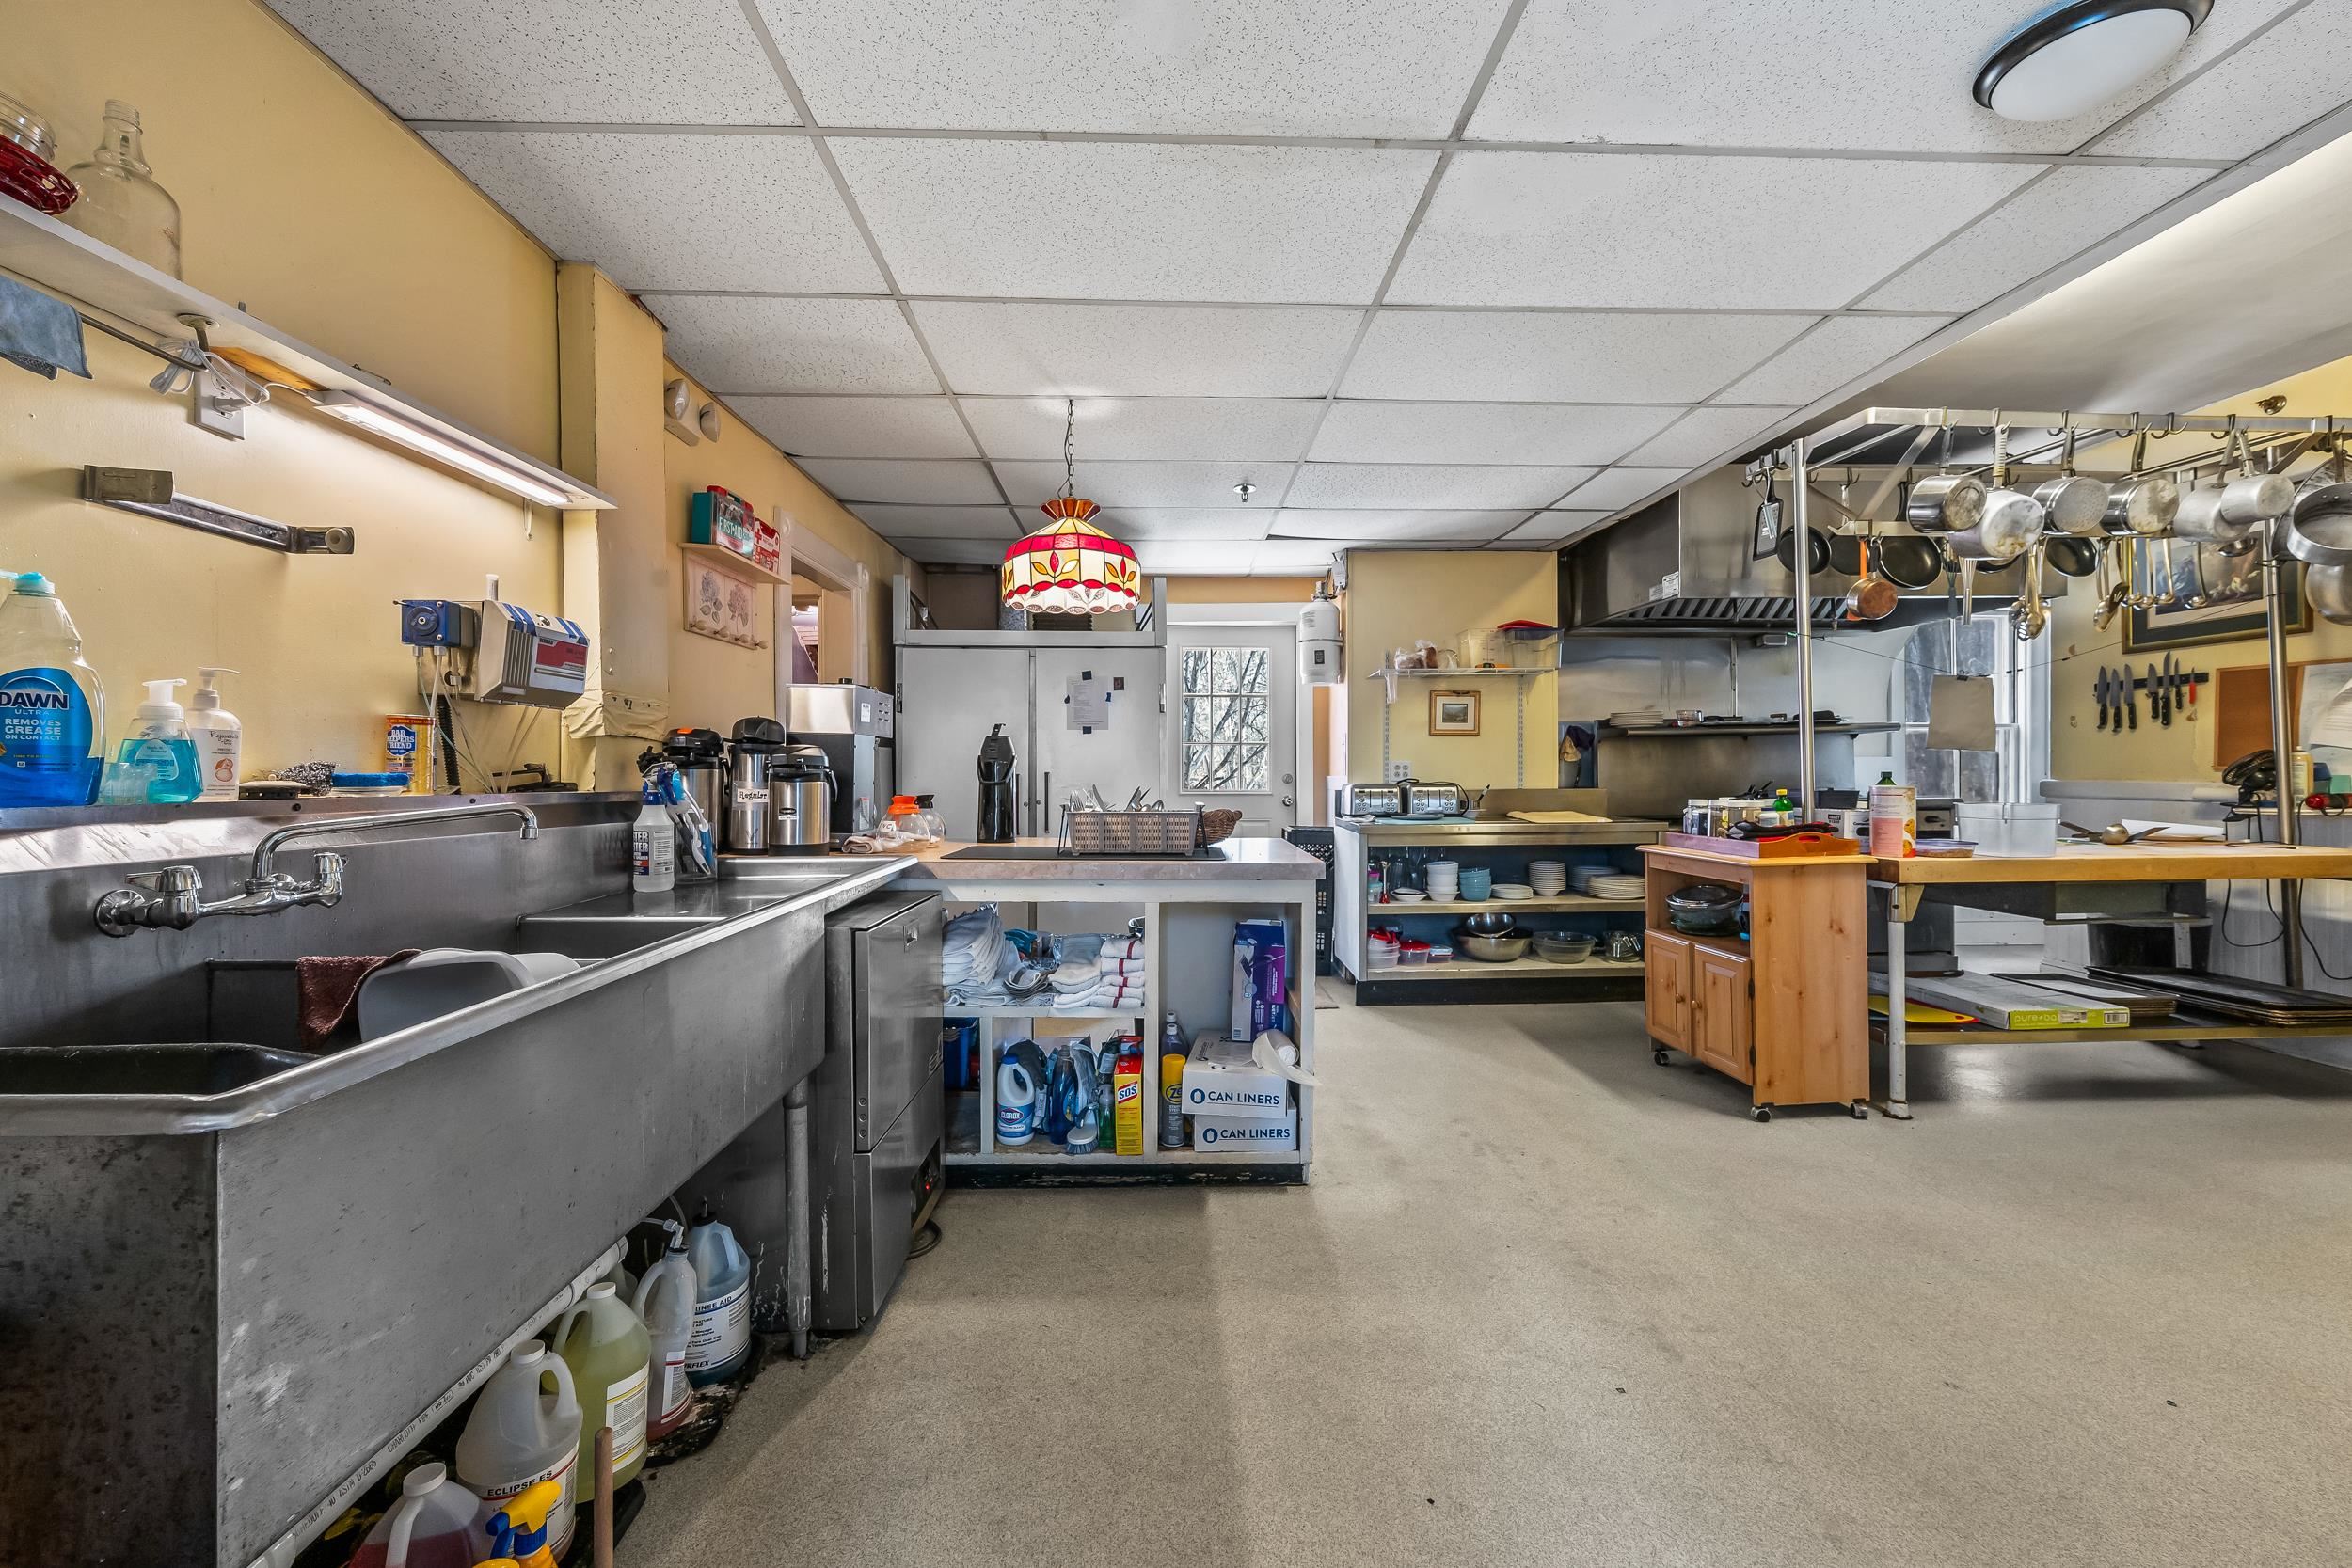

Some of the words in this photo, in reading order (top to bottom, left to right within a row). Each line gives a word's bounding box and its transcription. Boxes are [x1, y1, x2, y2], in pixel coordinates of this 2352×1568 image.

[0, 690, 69, 710] DAWN
[5, 725, 61, 735] GREASE
[739, 791, 768, 800] Regular
[1119, 1085, 1136, 1100] SOS
[1208, 1090, 1233, 1102] CAN
[1237, 1092, 1279, 1105] LINERS
[1000, 1111, 1021, 1119] CLOROX
[1220, 1129, 1246, 1139] CAN
[1249, 1128, 1291, 1139] LINERS
[720, 1295, 732, 1306] AID
[487, 1478, 536, 1497] ECLIPSE
[539, 1469, 553, 1483] ES
